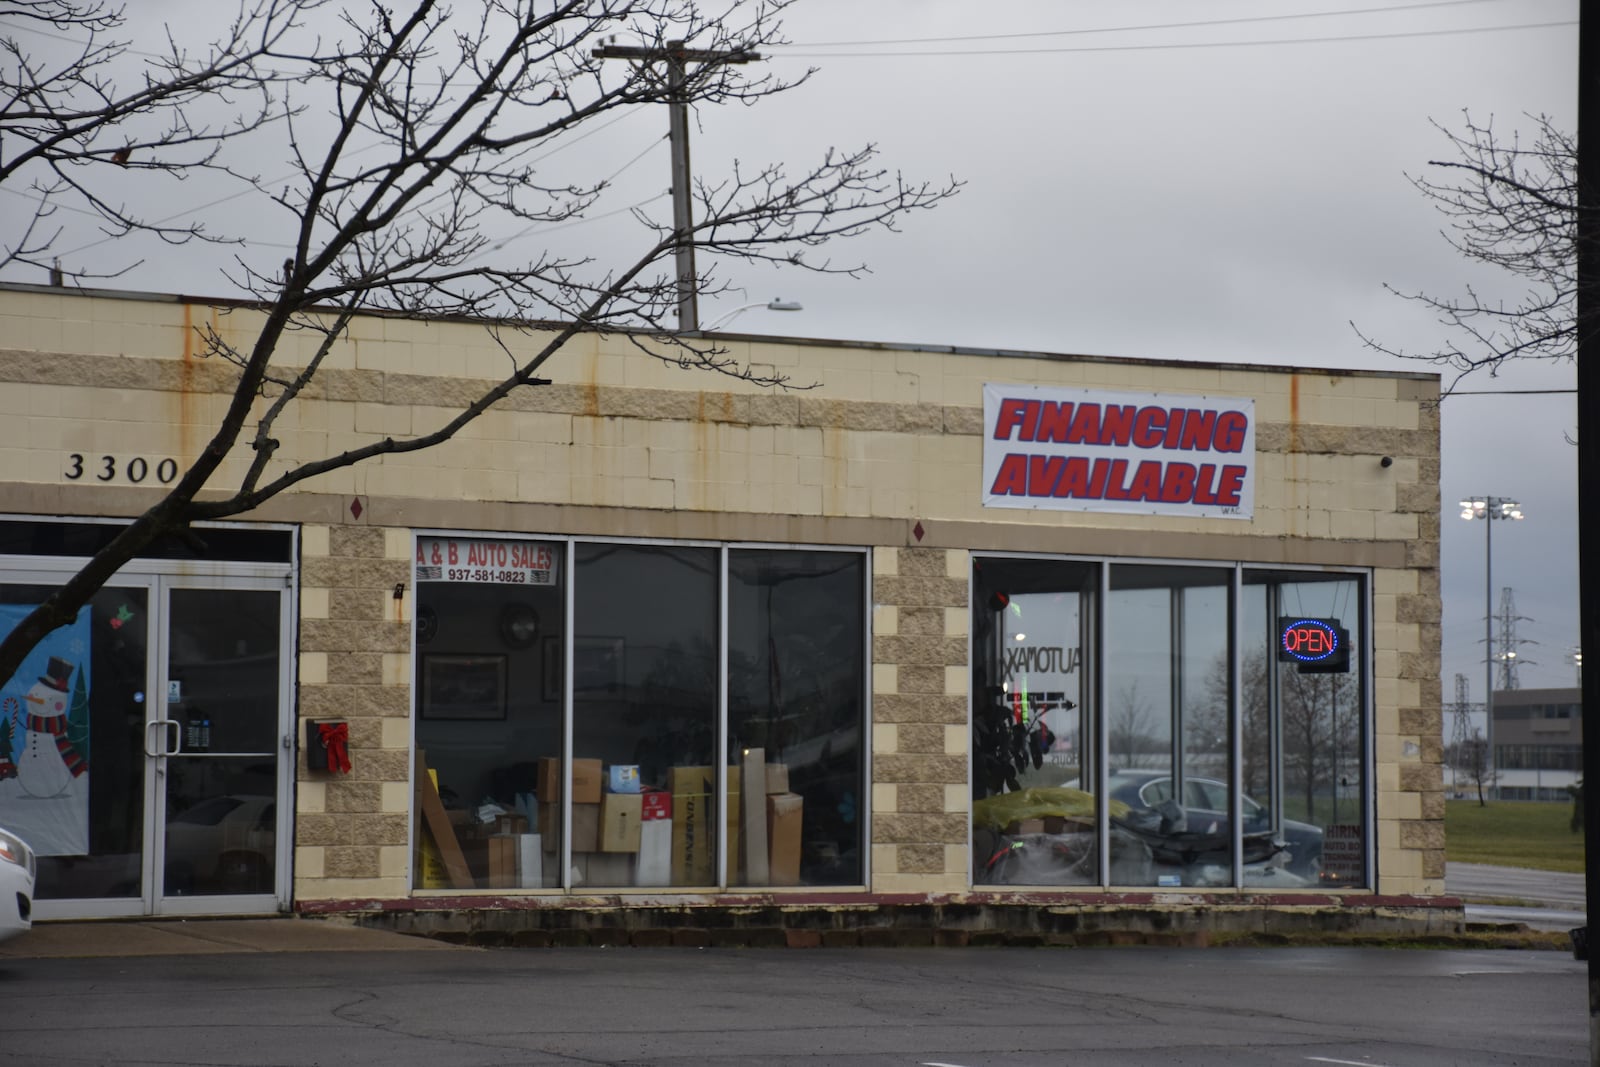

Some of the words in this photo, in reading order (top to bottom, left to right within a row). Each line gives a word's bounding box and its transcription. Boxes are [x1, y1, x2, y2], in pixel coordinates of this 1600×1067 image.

[993, 398, 1248, 453] FINANCING
[64, 453, 178, 484] 3300
[990, 453, 1247, 506] AVAILABLE
[416, 542, 427, 566] A
[431, 542, 443, 566] &
[448, 542, 459, 566] B
[467, 543, 508, 568] AUTO
[511, 544, 553, 570] SALES
[448, 568, 526, 583] 937-581-0823
[1285, 629, 1333, 652] OPEN
